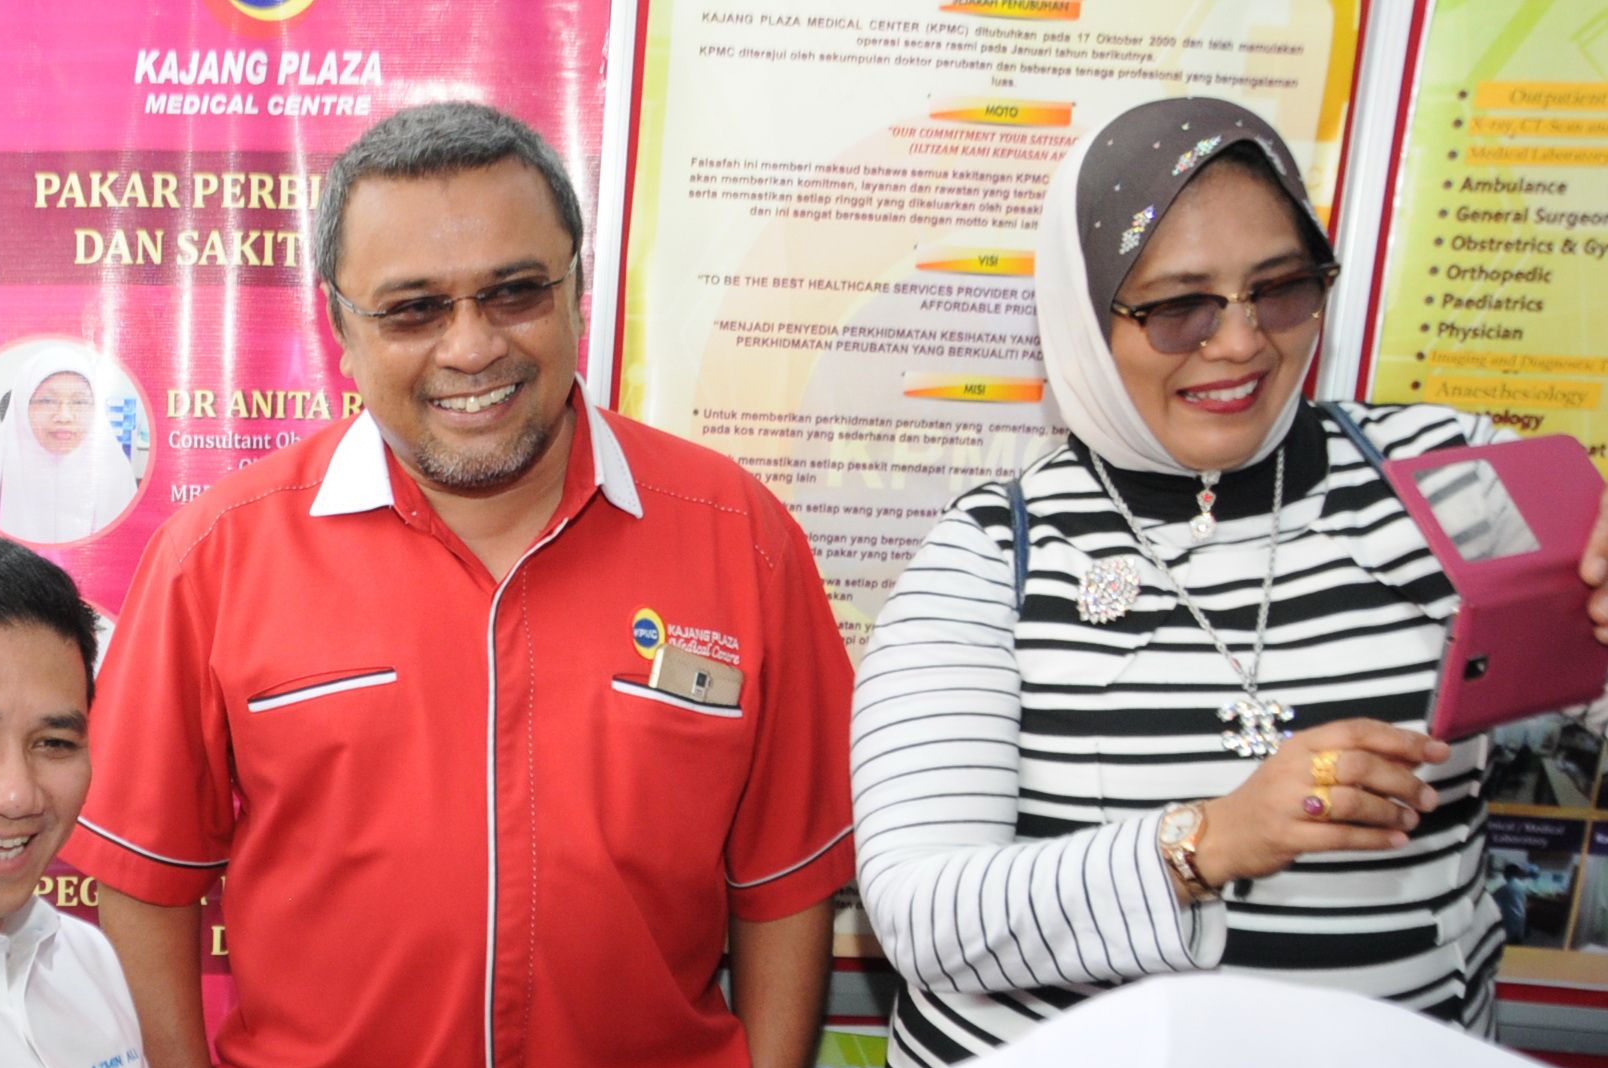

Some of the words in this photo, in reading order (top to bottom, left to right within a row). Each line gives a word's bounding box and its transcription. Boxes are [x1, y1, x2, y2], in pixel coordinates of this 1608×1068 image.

[702, 12, 753, 25] KAJANG
[760, 15, 800, 27] PLAZA
[808, 17, 862, 30] MEDICAL
[870, 20, 919, 32] CENTER
[926, 22, 969, 37] (KPMC)
[975, 26, 1037, 40] ditubuhkan
[1043, 31, 1070, 42] pada
[1077, 32, 1090, 42] 17
[1096, 33, 1142, 46] Oktober
[856, 36, 899, 48] operasi
[904, 40, 941, 50] secara
[946, 41, 977, 51] rasmi
[981, 44, 1007, 55] pada
[1011, 44, 1052, 57] Januari
[1055, 47, 1088, 58] tahun
[134, 49, 268, 85] KAJANG
[277, 49, 384, 86] PLAZA
[699, 46, 734, 58] KPMC
[791, 51, 815, 62] oleh
[819, 53, 890, 67] sekumpulan
[895, 54, 932, 66] doktor
[936, 56, 992, 71] perubatan
[996, 60, 1017, 72] dan
[1020, 62, 1071, 77] beberapa
[1118, 66, 1182, 81] profesional
[145, 92, 260, 115] MEDICAL
[267, 93, 372, 116] CENTRE
[985, 104, 1019, 118] MOTO
[919, 127, 995, 142] COMMITMENT
[999, 131, 1026, 144] YOUR
[961, 146, 990, 158] KAMI
[993, 147, 1049, 161] KEPUASAN
[691, 157, 740, 170] Falsafah
[743, 160, 758, 170] ini
[761, 161, 811, 172] memberi
[815, 163, 860, 175] maksud
[863, 165, 907, 177] bahawa
[910, 168, 949, 179] semua
[952, 169, 1013, 185] kakitangan
[1015, 173, 1050, 185] KPMC
[34, 170, 181, 209] PAKAR
[689, 173, 718, 183] akan
[721, 175, 793, 186] memberikan
[861, 181, 906, 195] layanan
[909, 182, 931, 193] dan
[935, 184, 979, 197] rawatan
[983, 187, 1010, 200] yang
[1459, 176, 1568, 195] Ambulance
[688, 189, 718, 199] serta
[721, 190, 793, 202] memastikan
[796, 193, 832, 206] setiap
[835, 194, 872, 208] ringgit
[876, 196, 905, 210] yang
[909, 196, 975, 211] dikeluarkan
[979, 200, 1002, 212] oleh
[749, 206, 771, 217] dan
[775, 207, 790, 217] ini
[793, 209, 832, 222] sangat
[835, 210, 905, 224] bersesuaian
[909, 214, 952, 227] dengan
[955, 216, 988, 228] motto
[991, 218, 1017, 229] kami
[1455, 205, 1529, 223] General
[73, 228, 166, 266] DAN
[176, 228, 303, 268] SAKIT
[1451, 234, 1554, 254] Obstretrics
[1561, 238, 1577, 255] &
[978, 255, 999, 267] VISI
[1446, 263, 1552, 286] Orthopedic
[724, 275, 741, 286] BE
[745, 276, 768, 288] THE
[772, 277, 805, 289] BEST
[808, 279, 890, 293] HEALTHCARE
[893, 283, 954, 297] SERVICES
[957, 286, 1018, 300] PROVIDER
[920, 299, 1001, 315] AFFORDABLE
[1442, 292, 1545, 313] Paediatrics
[778, 323, 839, 336] PENYEDIA
[842, 325, 937, 341] PERKHIDMATAN
[940, 330, 1007, 344] KESIHATAN
[1010, 334, 1041, 346] YANG
[1437, 321, 1525, 344] Physician
[736, 336, 833, 351] PERKHIDMATAN
[836, 340, 909, 355] PERUBATAN
[911, 344, 945, 356] YANG
[948, 346, 1019, 361] BERKUALITI
[963, 384, 986, 395] MISI
[1434, 381, 1588, 407] Anaesthesiology
[166, 388, 217, 419] DR
[225, 388, 332, 420] ANITA
[703, 408, 737, 419] Untuk
[741, 411, 812, 424] memberikan
[815, 413, 893, 428] perkhidmatan
[895, 417, 952, 431] perubatan
[955, 421, 982, 434] yang
[168, 430, 271, 450] Consultant
[702, 425, 730, 436] pada
[734, 425, 755, 435] kos
[758, 427, 803, 438] rawatan
[807, 430, 835, 442] yang
[838, 430, 896, 443] sederhana
[899, 431, 921, 443] dan
[923, 433, 983, 446] berpatutan
[738, 455, 807, 468] memastikan
[810, 459, 844, 471] setiap
[847, 460, 887, 472] pesakit
[890, 463, 946, 476] mendapat
[949, 466, 991, 477] rawatan
[995, 467, 1016, 478] dan
[765, 473, 793, 485] yang
[796, 472, 817, 483] lain
[806, 503, 840, 515] setiap
[843, 507, 873, 518] wang
[876, 508, 903, 520] yang
[851, 537, 878, 548] yang
[826, 547, 857, 559] pakar
[860, 550, 888, 562] yang
[844, 578, 879, 590] setiap
[711, 631, 740, 651] PLAZA
